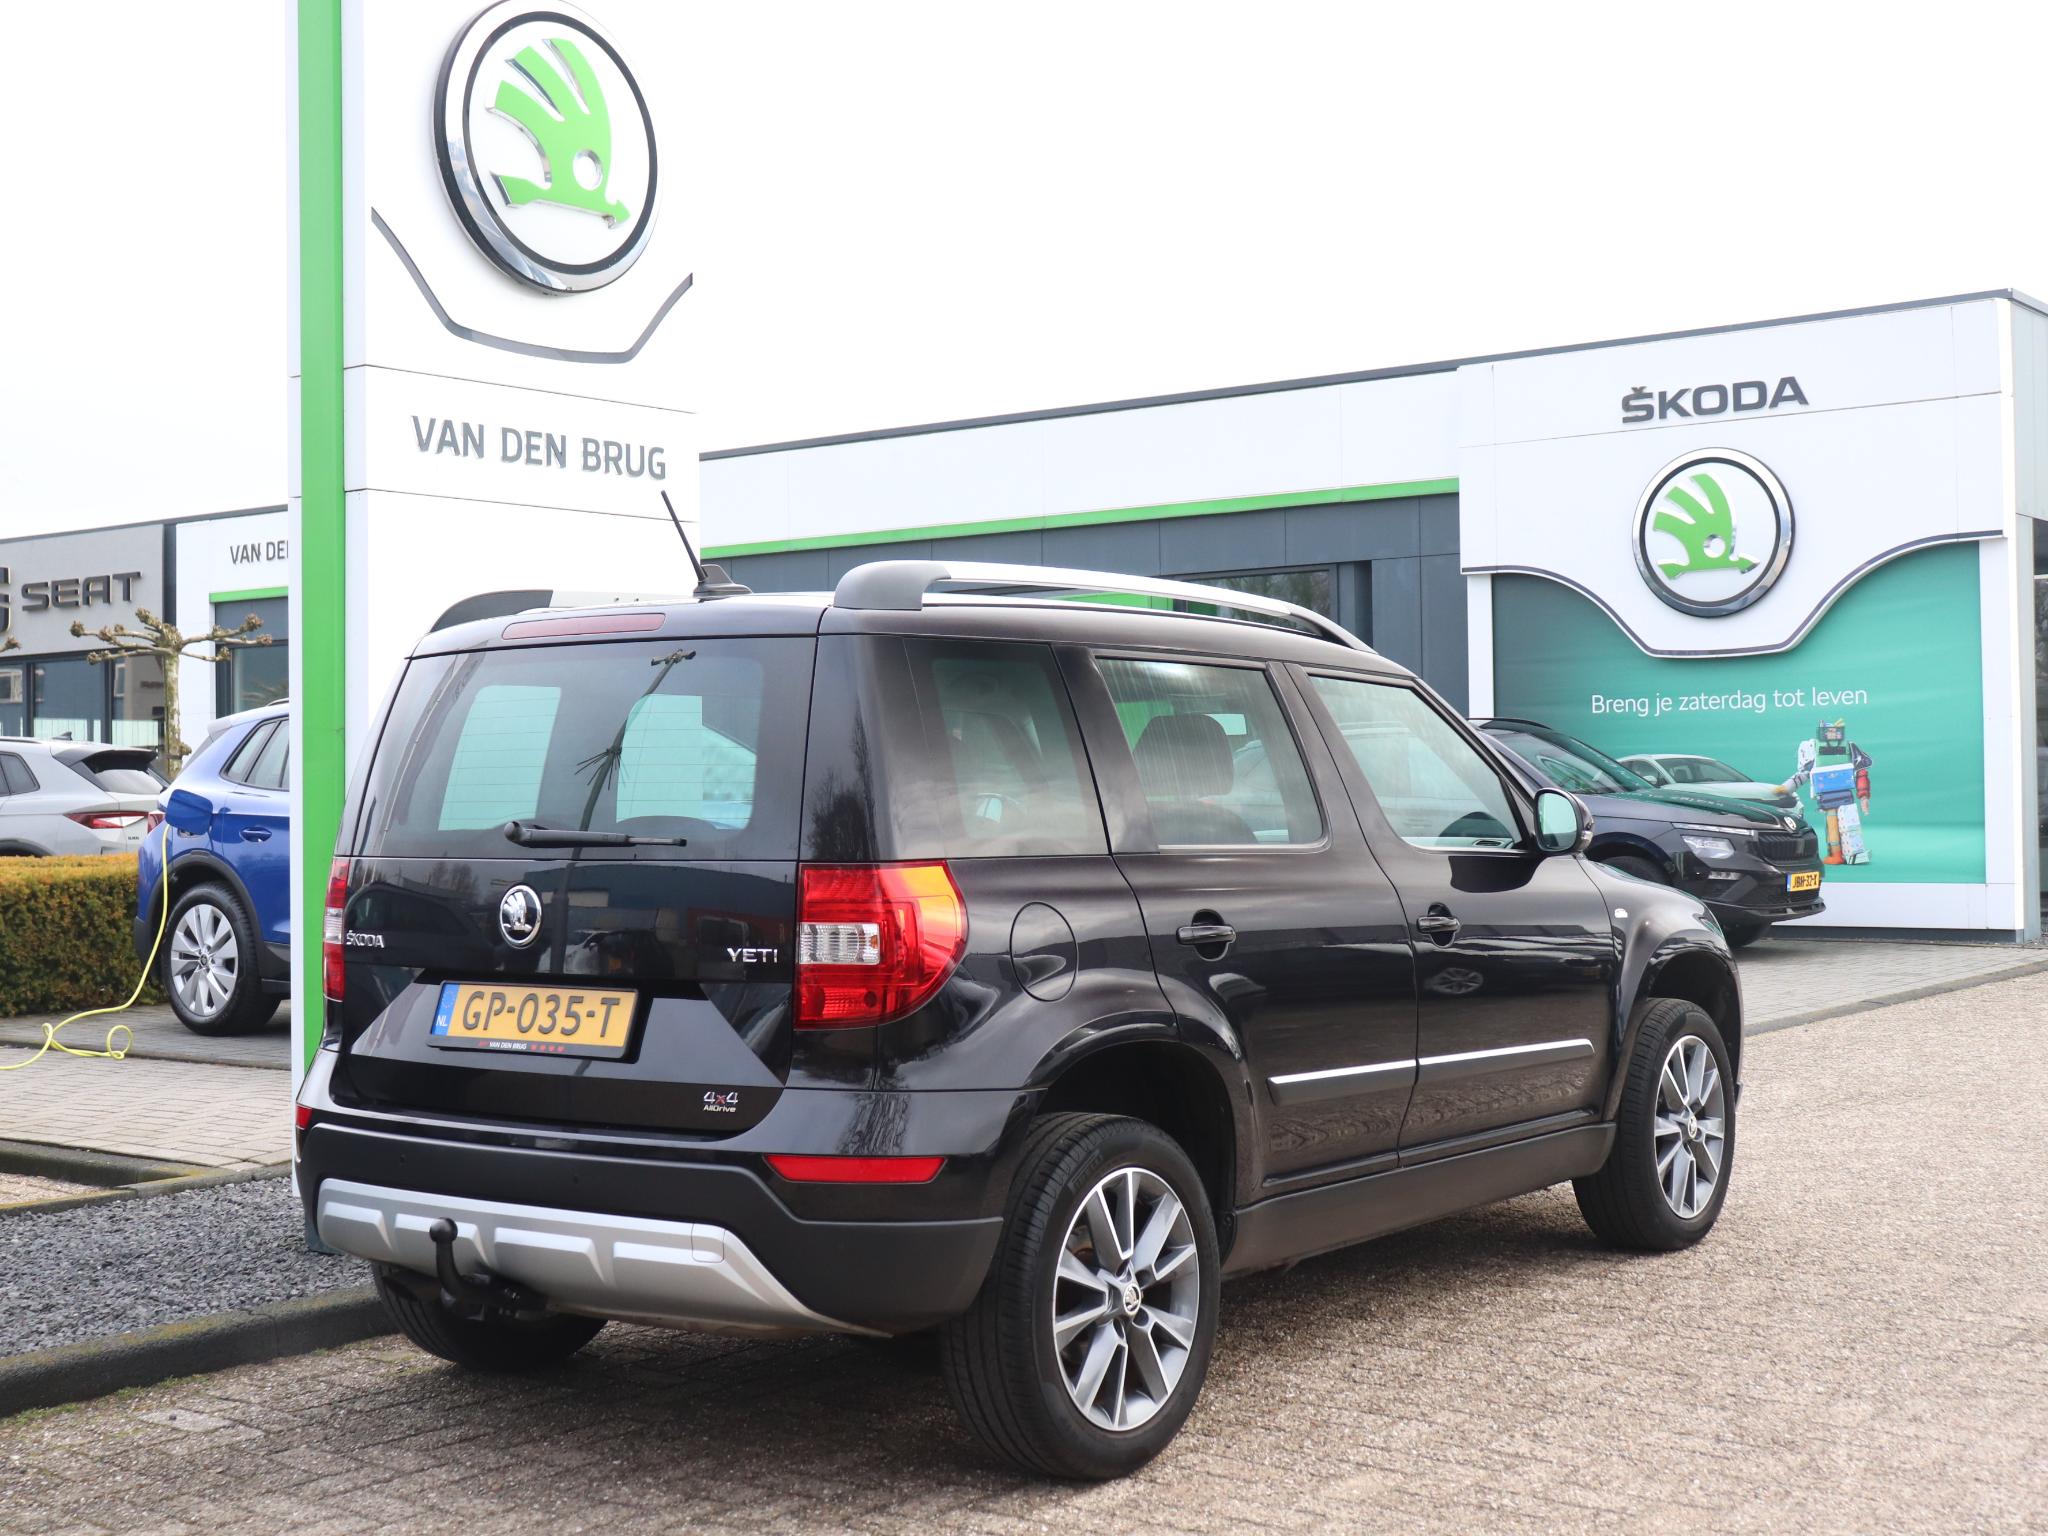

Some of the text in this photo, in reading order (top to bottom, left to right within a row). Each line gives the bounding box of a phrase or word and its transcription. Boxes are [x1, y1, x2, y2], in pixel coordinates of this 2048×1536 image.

[1621, 376, 1809, 424] ŠKODA
[411, 415, 667, 481] VAN DEN BRUG
[229, 540, 288, 565] VAN DE
[21, 571, 142, 611] SEAT
[1591, 686, 1868, 718] Breng je zaterdag tot leven
[346, 929, 385, 948] ŠKODA
[727, 947, 778, 963] YETI
[436, 1014, 448, 1027] NL
[462, 990, 621, 1038] GP-035-T
[703, 1091, 739, 1104] 4x4
[703, 1104, 737, 1113] AllDrive
